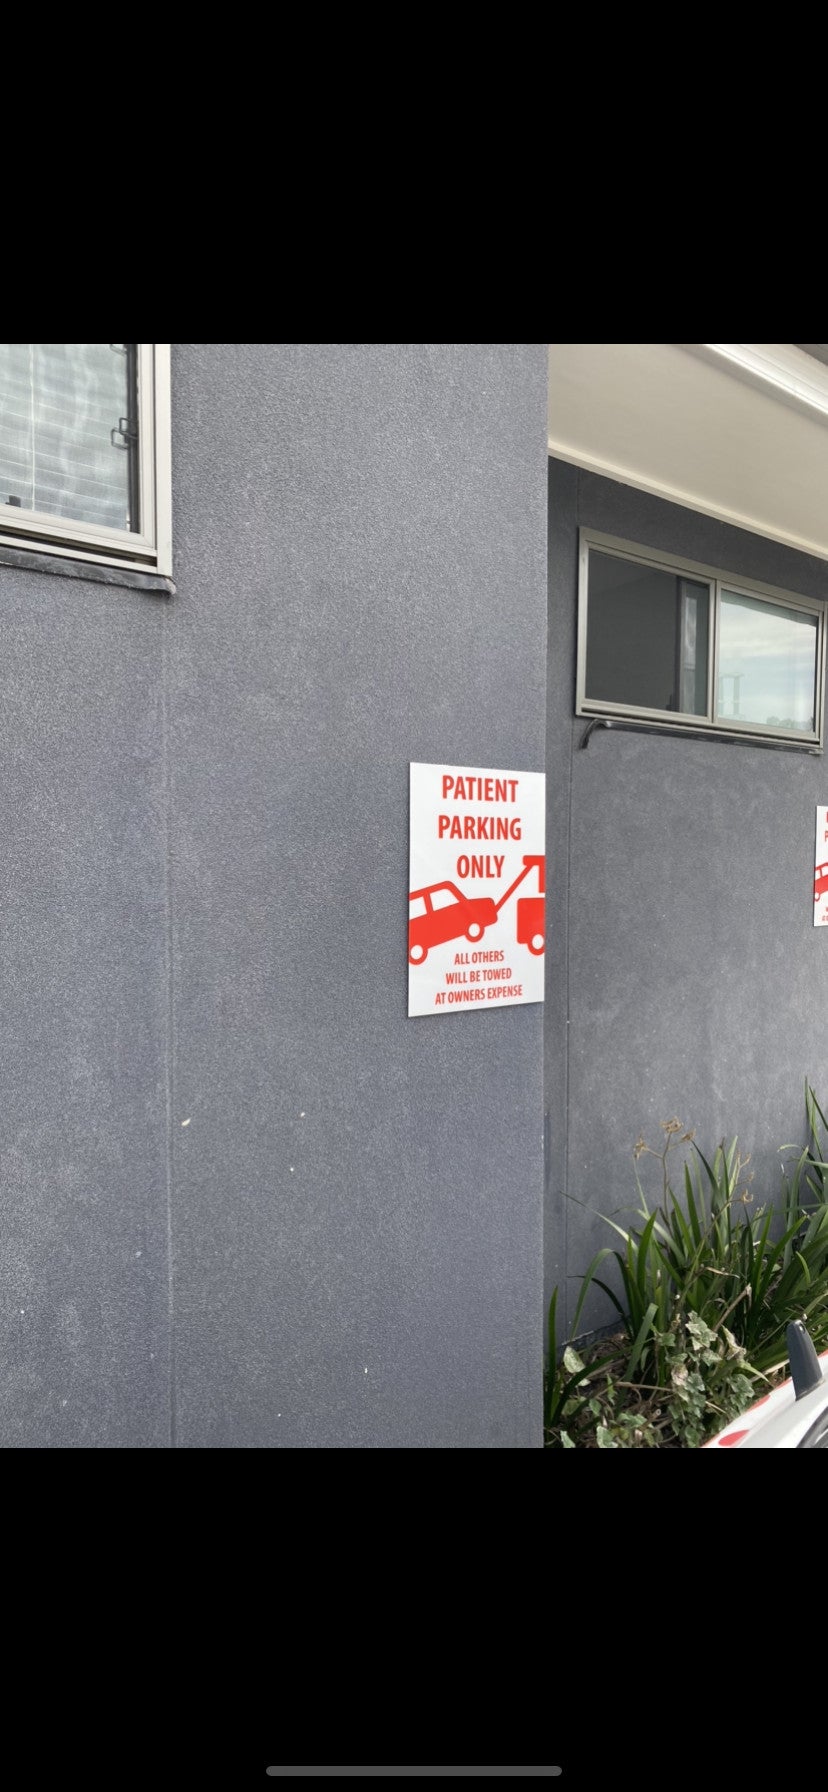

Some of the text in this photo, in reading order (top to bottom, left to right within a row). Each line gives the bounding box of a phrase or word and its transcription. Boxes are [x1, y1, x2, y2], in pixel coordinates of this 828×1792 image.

[442, 775, 519, 802] PATIENT
[438, 815, 522, 840] PARKING
[456, 855, 505, 878] ONLY
[454, 950, 504, 965] ALL OTHERS
[445, 968, 512, 985] WILL BE TOWED
[435, 985, 522, 1005] AT OWNERS EXPENSE
